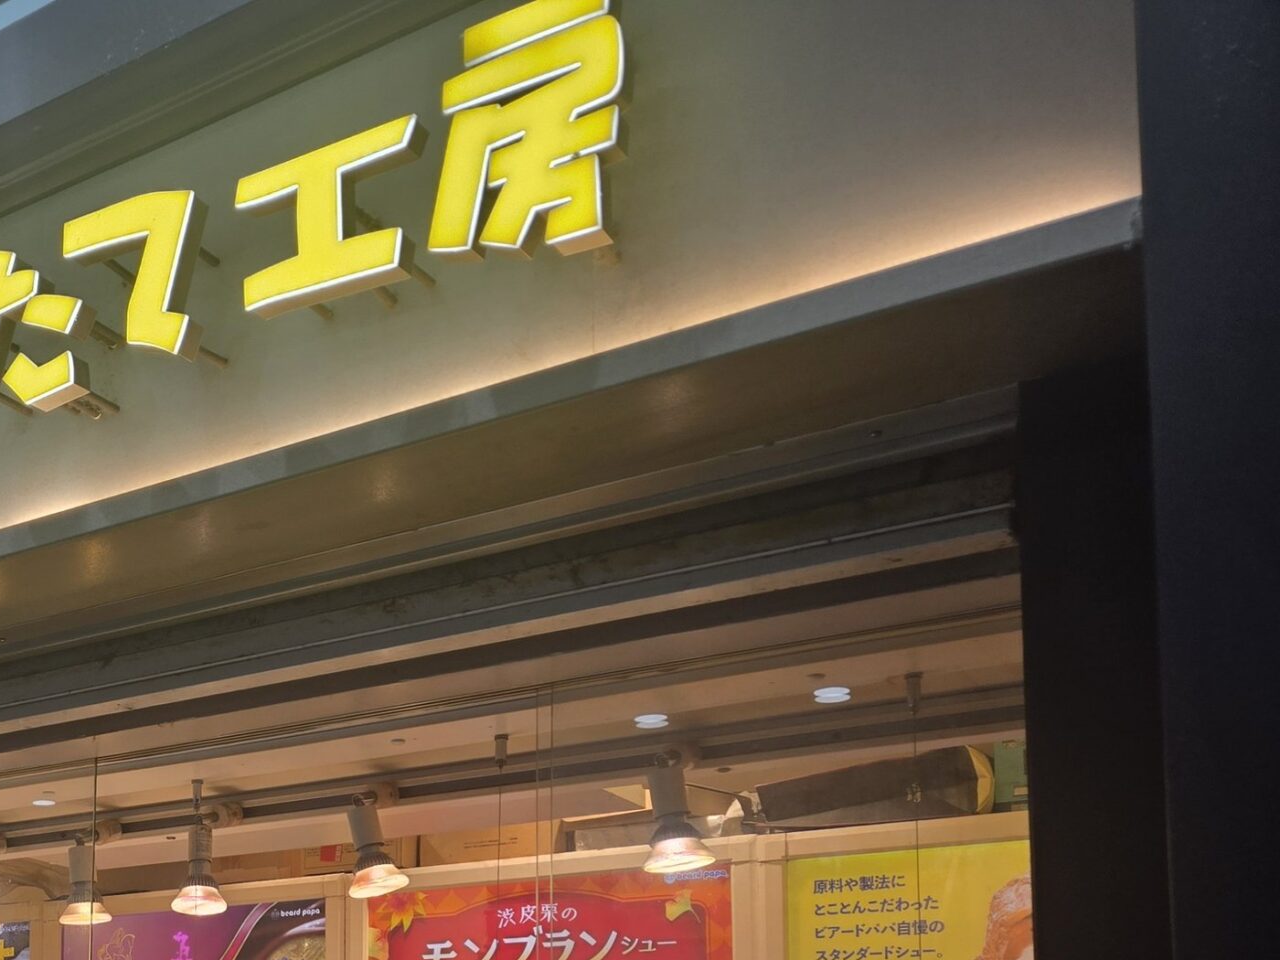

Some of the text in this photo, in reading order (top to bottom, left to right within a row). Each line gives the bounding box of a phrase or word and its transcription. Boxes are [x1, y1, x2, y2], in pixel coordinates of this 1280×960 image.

[703, 869, 728, 880] papa
[813, 874, 906, 895] 原料や製法に
[280, 908, 320, 918] beard papa
[497, 903, 577, 928] 渋皮栗の
[814, 896, 939, 916] とことんこだわった
[815, 919, 944, 939] ビアードパパ自慢の
